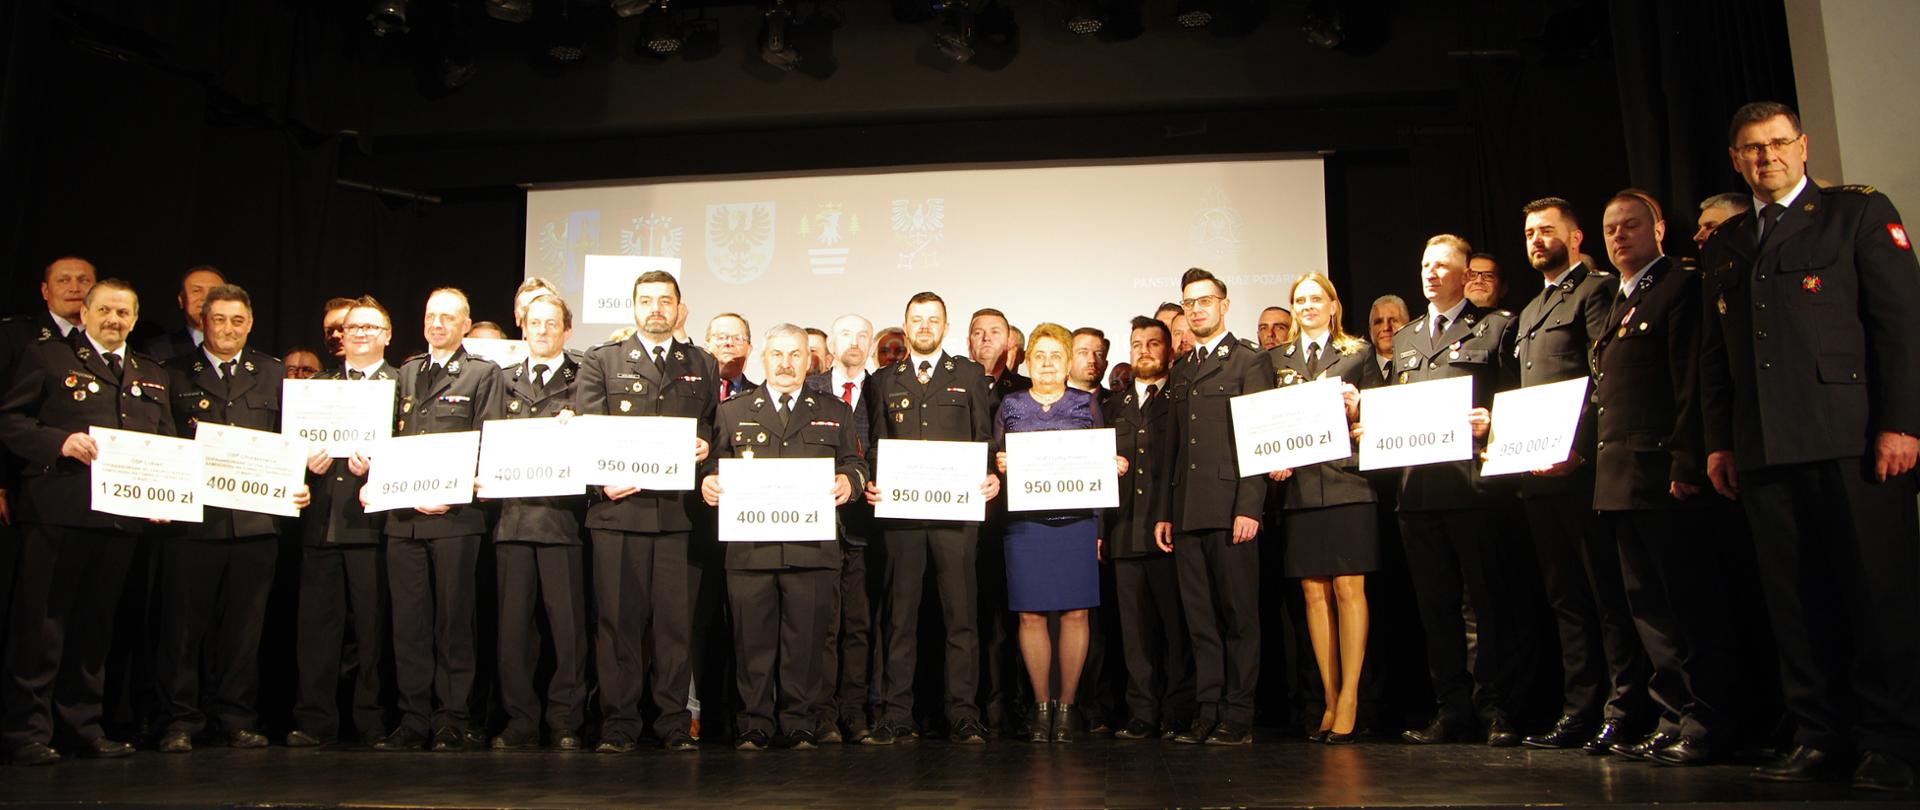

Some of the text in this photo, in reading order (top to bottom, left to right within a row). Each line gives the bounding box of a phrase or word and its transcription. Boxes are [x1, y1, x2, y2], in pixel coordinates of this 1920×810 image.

[597, 297, 620, 309] 950
[299, 428, 376, 442] 950 000 zł
[1254, 430, 1331, 456] 400 000 zł
[1376, 429, 1454, 450] 400 000 zł
[1500, 440, 1523, 456] 950
[1526, 434, 1549, 453] 000
[494, 467, 521, 481] 400
[526, 465, 554, 480] 000
[597, 458, 678, 475] 950 000 zł
[102, 482, 193, 503] 1 250 000 zł
[206, 476, 286, 498] 400 000 zł
[382, 477, 458, 496] 950 000 zł
[1024, 479, 1102, 494] 950 000 zł
[893, 489, 969, 504] 950 000 zł
[737, 510, 818, 524] 400 000 zł
